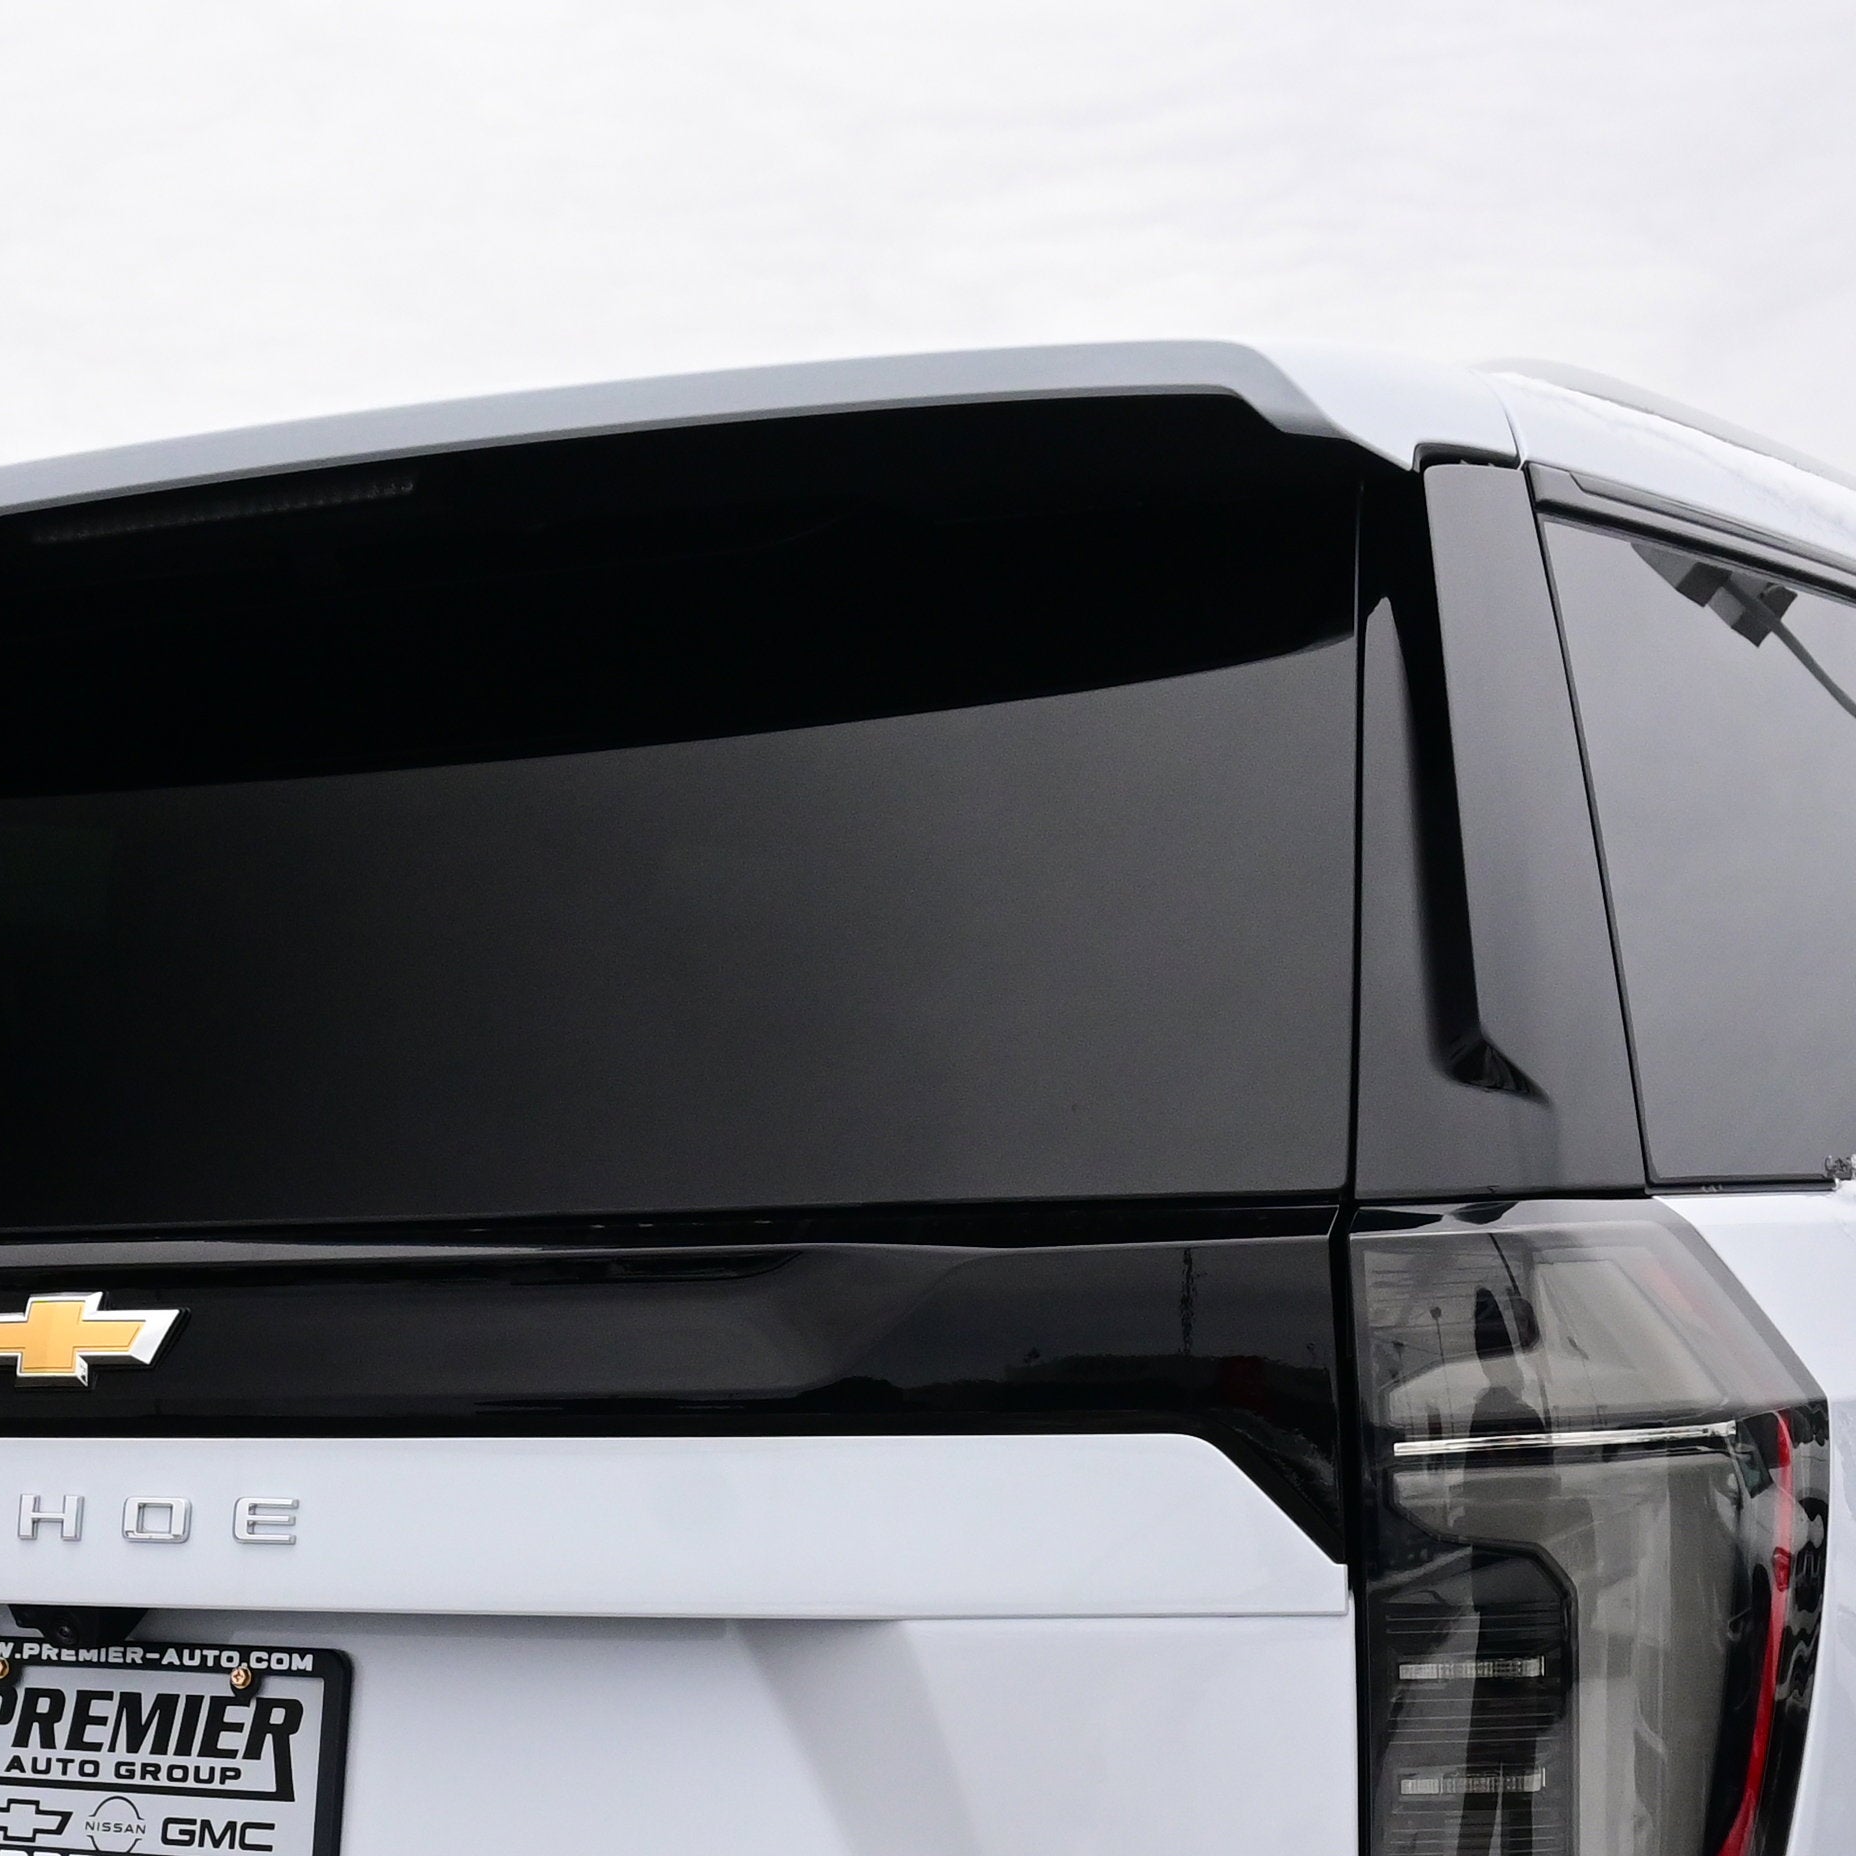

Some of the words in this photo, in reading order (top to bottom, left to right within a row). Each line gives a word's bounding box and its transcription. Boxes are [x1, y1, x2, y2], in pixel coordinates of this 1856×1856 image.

[4, 1754, 101, 1779] AUTO
[114, 1760, 243, 1785] GROUP
[85, 1820, 147, 1835] NISSAN
[161, 1816, 276, 1853] GMC
